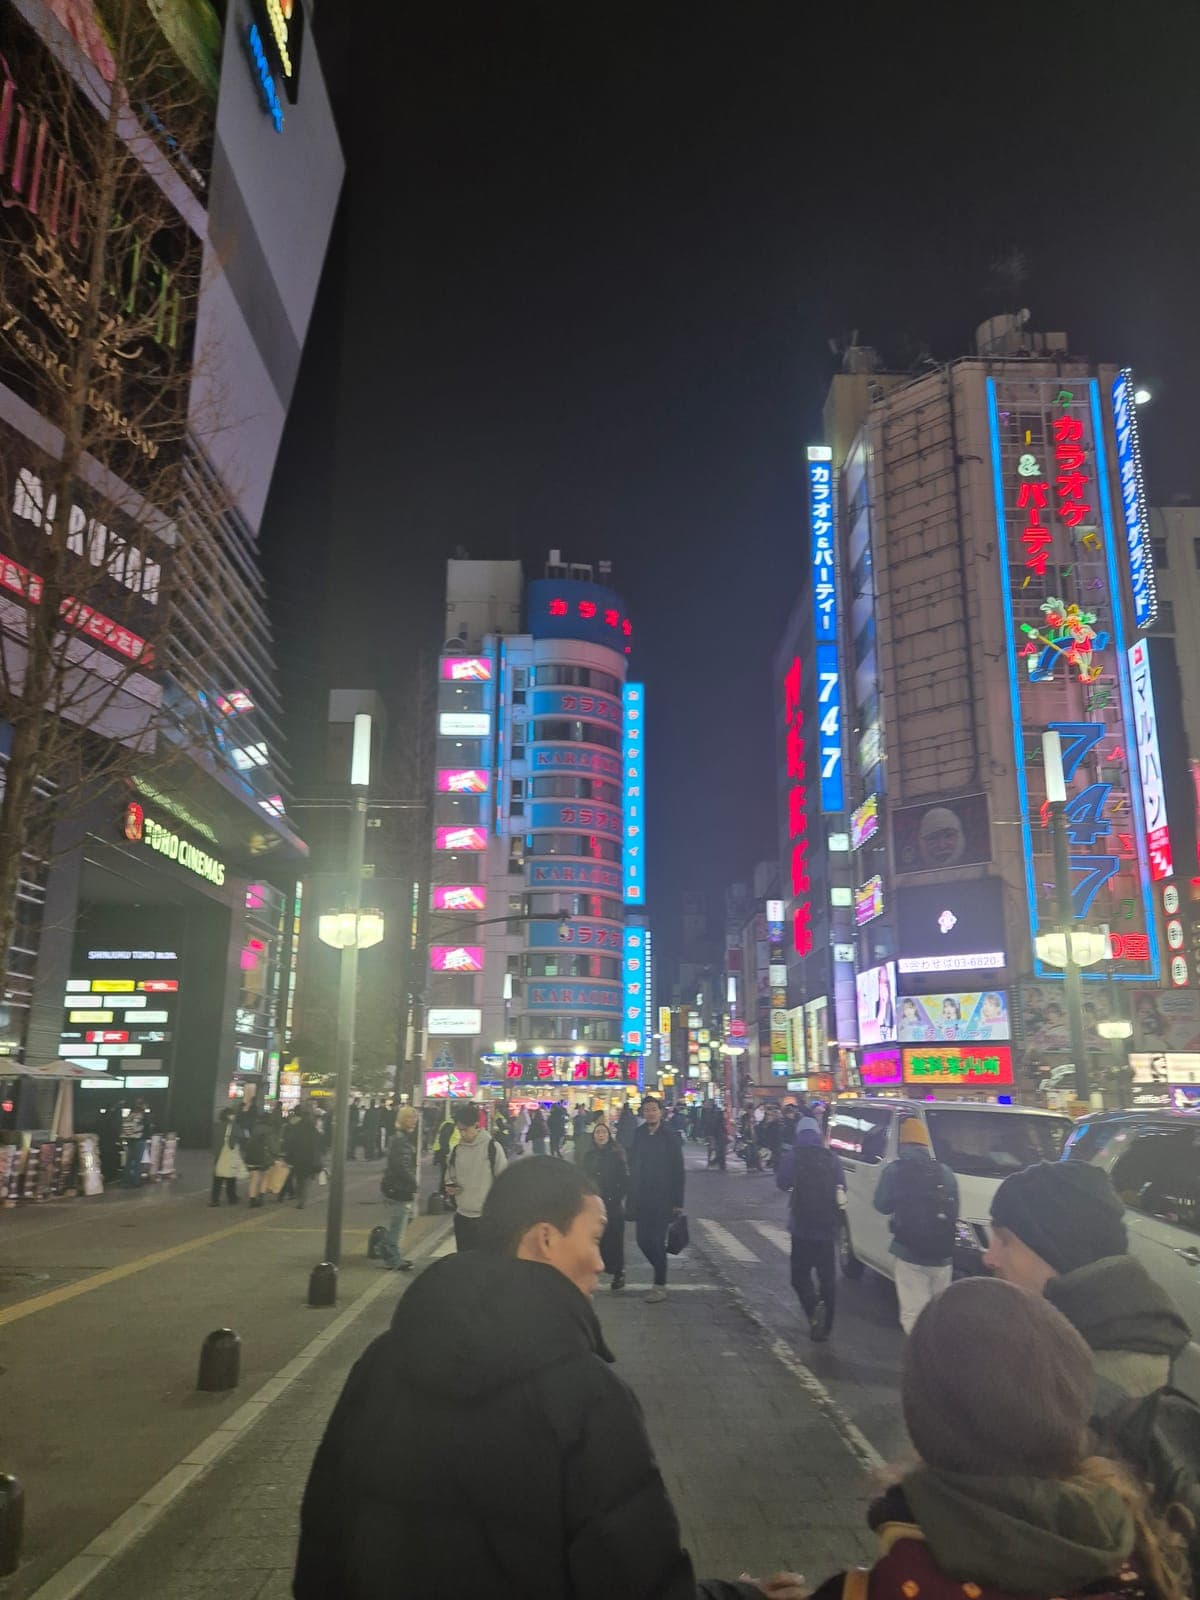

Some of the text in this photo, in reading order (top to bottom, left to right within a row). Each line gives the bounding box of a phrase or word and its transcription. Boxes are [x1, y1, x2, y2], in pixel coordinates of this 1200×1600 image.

[1052, 415, 1091, 527] カラオケ
[818, 672, 841, 779] 747
[1135, 670, 1161, 827] マルハン
[144, 818, 225, 886] TOHO CINEMAS
[1048, 722, 1119, 919] 747
